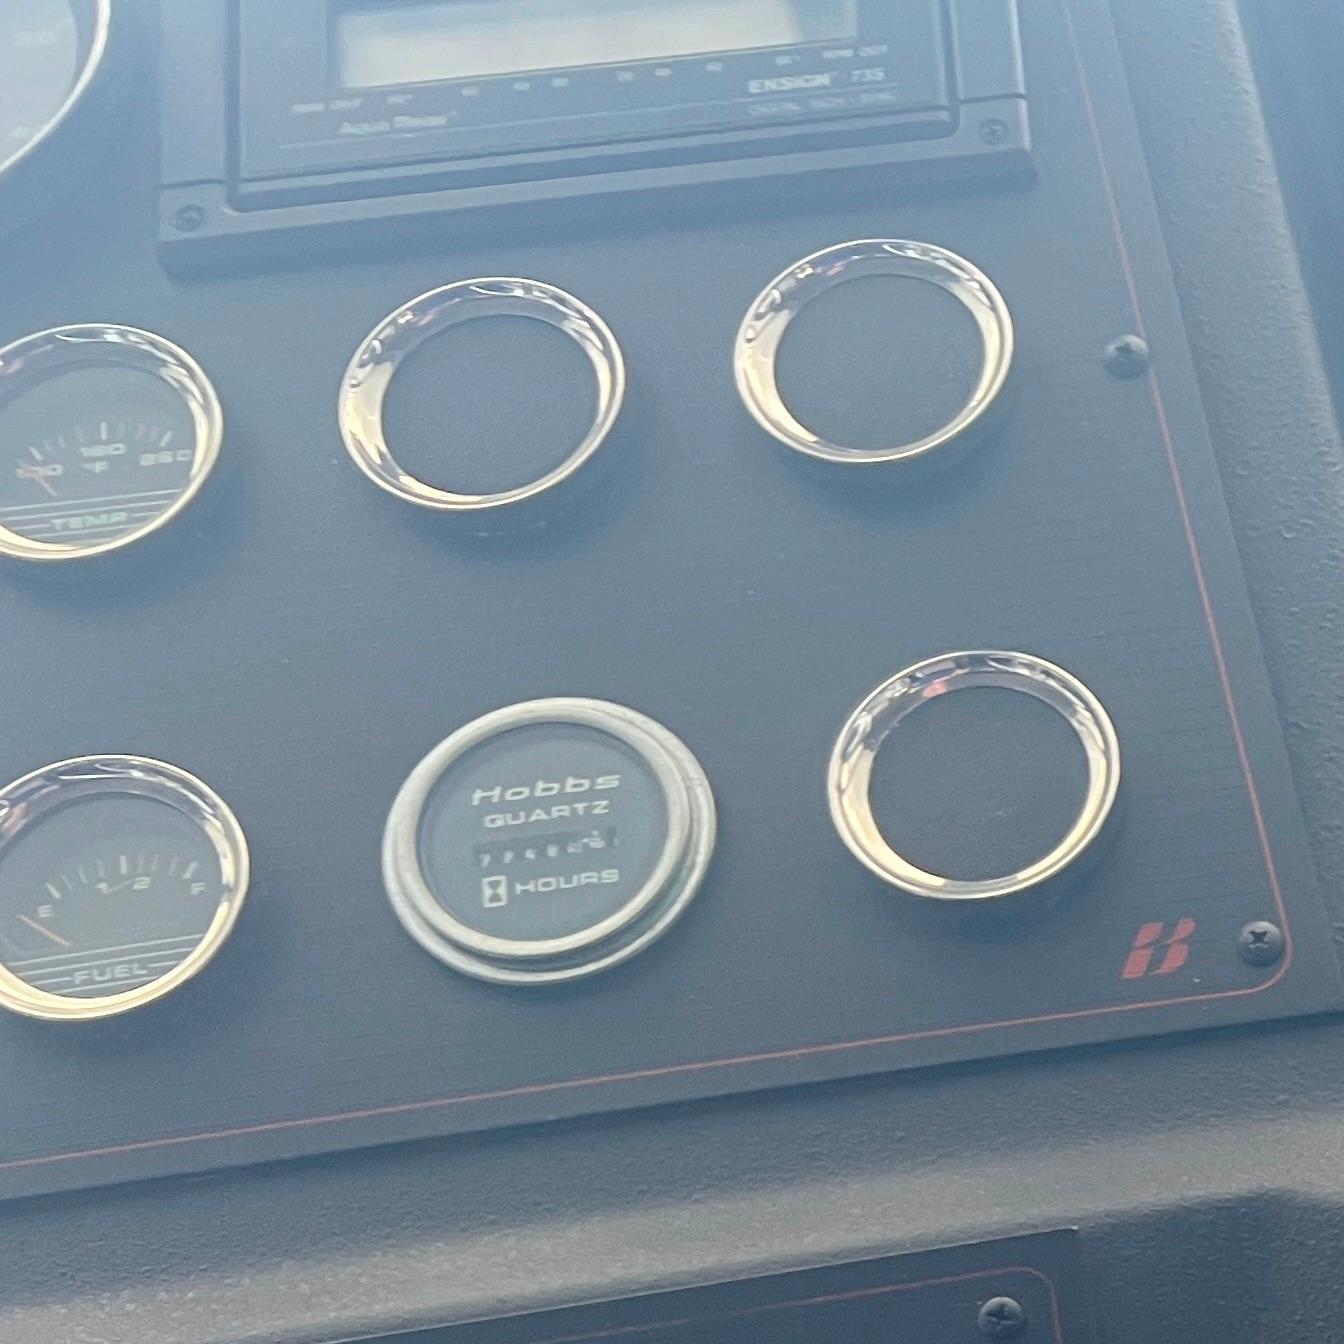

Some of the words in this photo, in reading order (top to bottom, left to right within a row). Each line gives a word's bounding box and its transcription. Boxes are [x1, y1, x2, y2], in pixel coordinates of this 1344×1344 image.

[472, 774, 622, 806] Hobbs
[483, 800, 610, 828] QUARTZ
[515, 869, 619, 895] HOURS
[74, 962, 149, 985] FUEL
